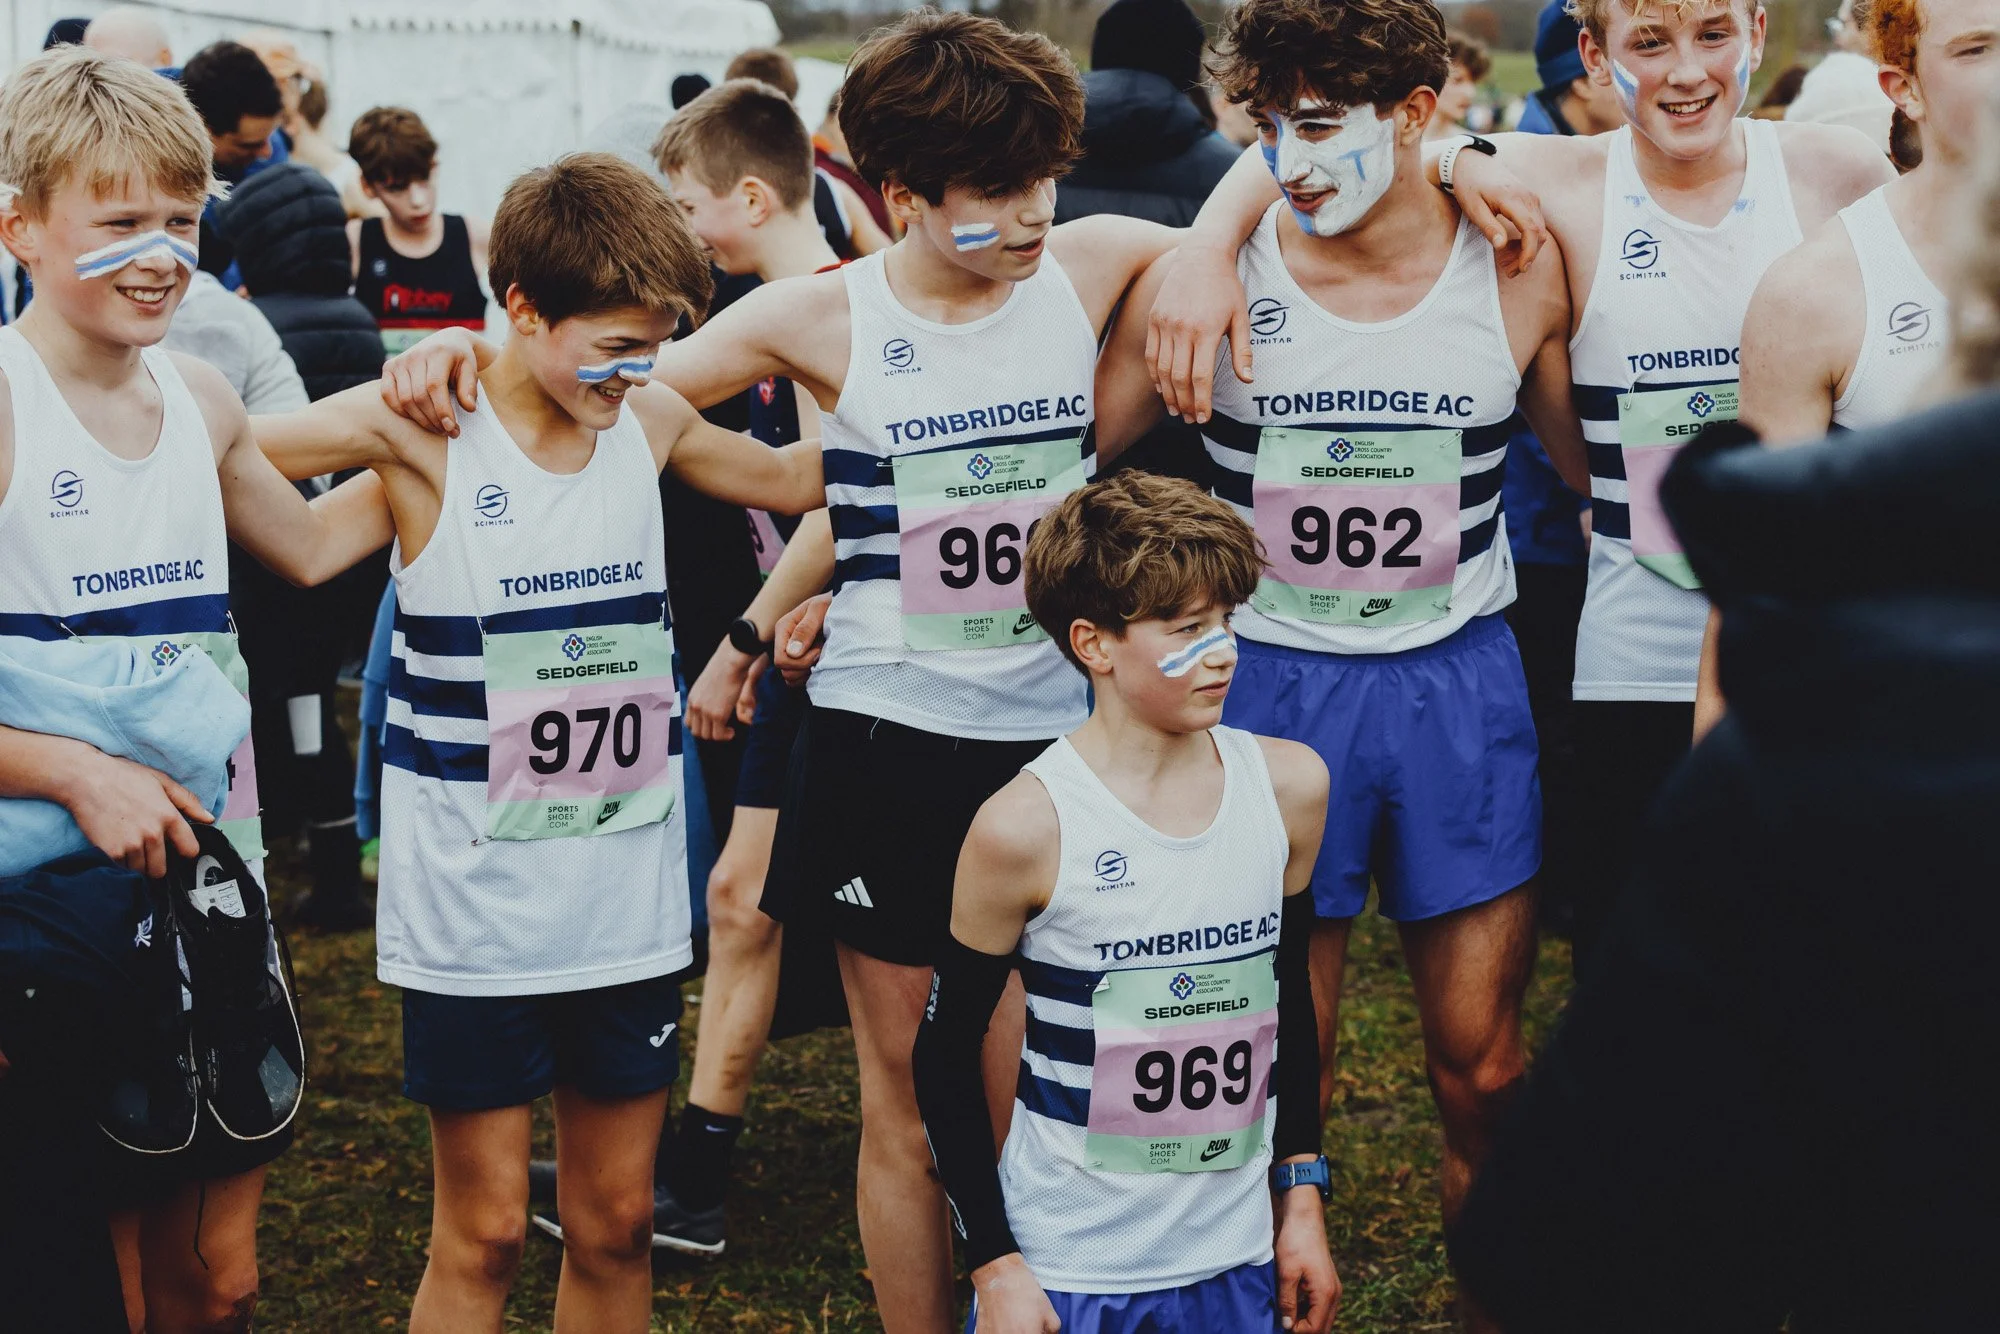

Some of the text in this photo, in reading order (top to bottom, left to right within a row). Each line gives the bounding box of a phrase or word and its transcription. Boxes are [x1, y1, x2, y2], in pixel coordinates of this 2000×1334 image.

[1619, 271, 1667, 281] SCIMITAR
[1249, 337, 1292, 345] CIMITAR
[1628, 347, 1739, 374] TONBRIDG
[884, 367, 922, 376] SCIMITAR
[1252, 390, 1474, 417] TONBRIDGE AC
[886, 395, 1086, 445] TONBRIDGE AC
[1300, 466, 1414, 479] SEDGEFIELD
[944, 477, 1047, 499] SEDGEFIELD
[50, 509, 89, 518] SCIMITAR
[474, 518, 514, 527] SCIMITAR
[1290, 505, 1423, 568] 962
[939, 518, 1041, 589] 96
[72, 559, 205, 597] TONBRIDGE AC
[499, 561, 644, 598] TONBRIDGE AC
[1309, 593, 1393, 609] SPORTS RUN
[1309, 600, 1336, 609] SHOES
[963, 617, 994, 626] SPORTS
[963, 625, 990, 633] SHOES
[536, 660, 638, 680] SEDGEFIELD
[529, 702, 641, 774] 970
[548, 800, 621, 815] SPORTS RUN
[547, 813, 575, 821] SHOES
[1095, 881, 1135, 892] SCIMITAR
[1093, 912, 1279, 961] TONBRIDGE AC
[1196, 986, 1224, 994] ASSOCIATION
[1144, 997, 1249, 1020] SEDGEFIELD
[1132, 1039, 1253, 1113] 969
[1150, 1138, 1231, 1152] SPORTS RUN
[1149, 1150, 1176, 1158] SHOES
